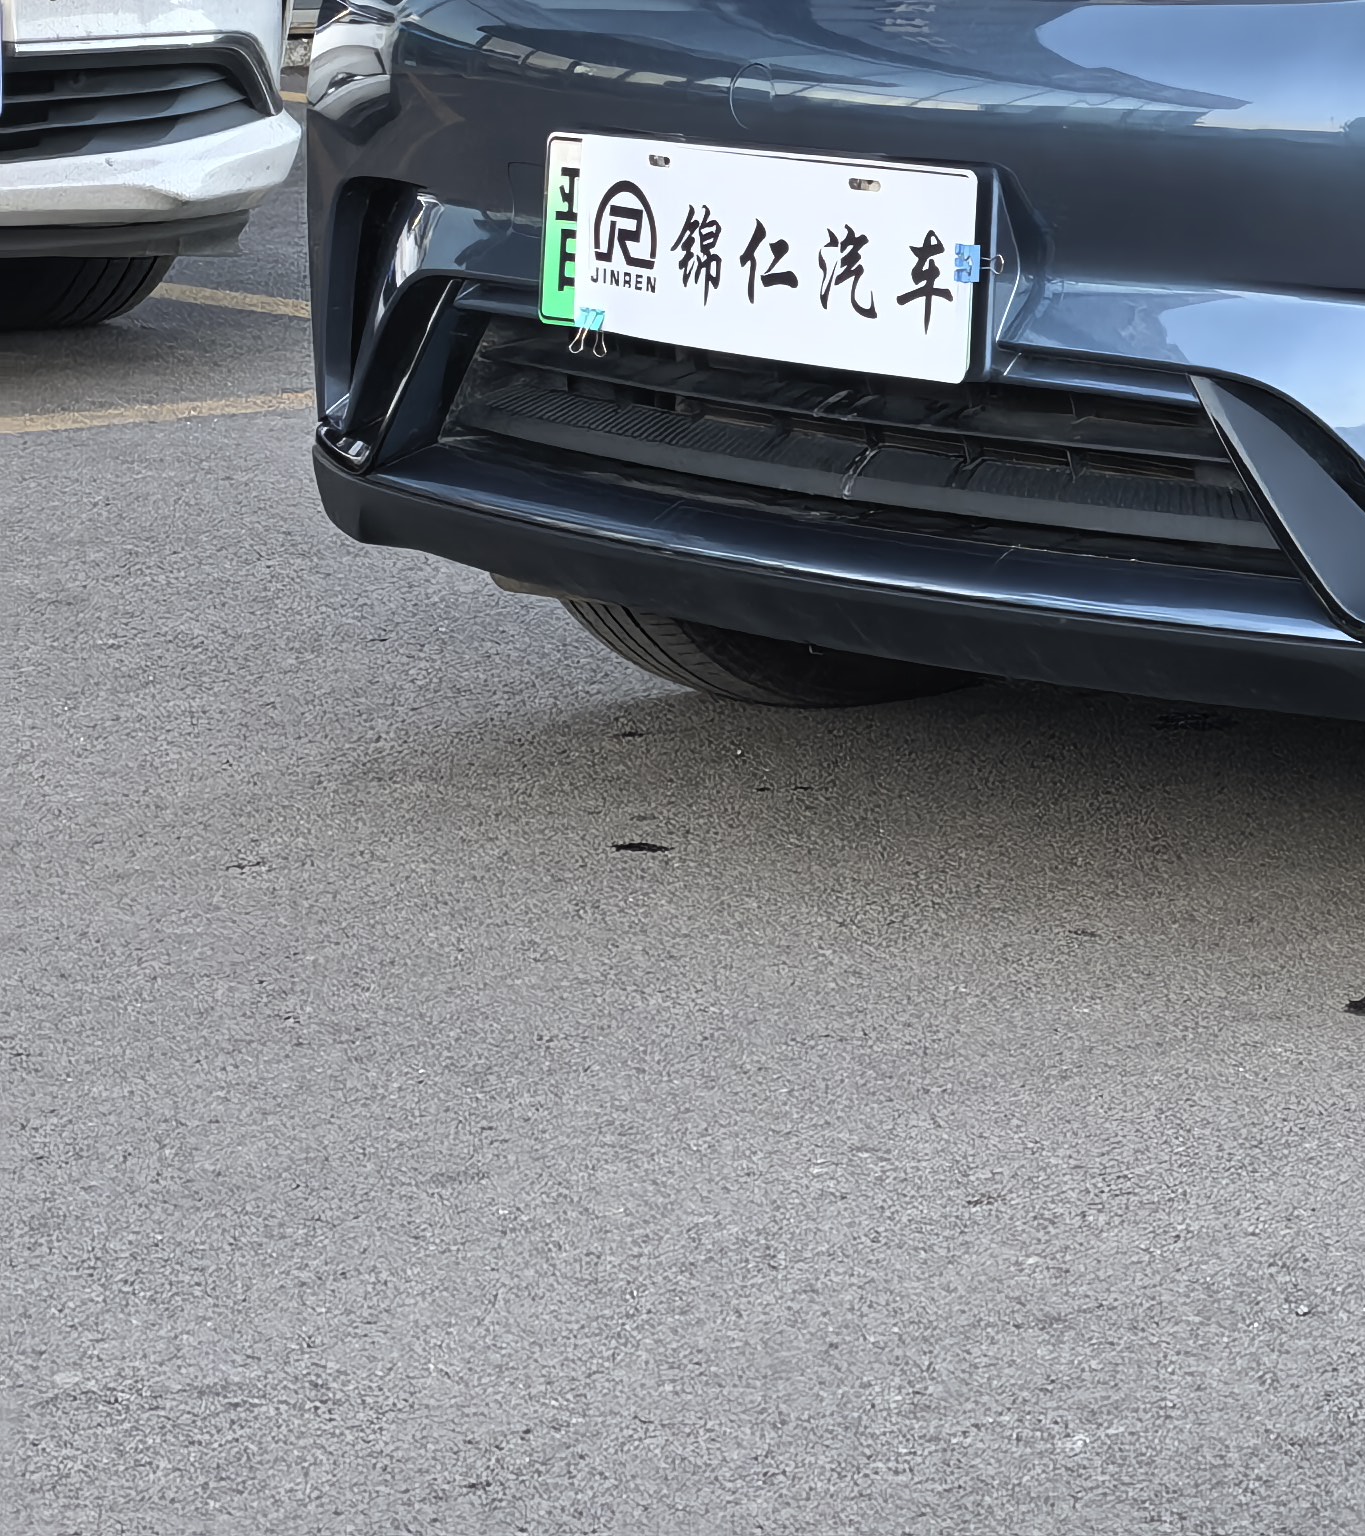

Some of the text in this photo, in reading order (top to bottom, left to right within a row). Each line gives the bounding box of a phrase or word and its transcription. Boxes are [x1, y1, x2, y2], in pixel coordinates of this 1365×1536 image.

[590, 267, 657, 294] JINREN
[670, 204, 954, 335] 锦仁汽车
